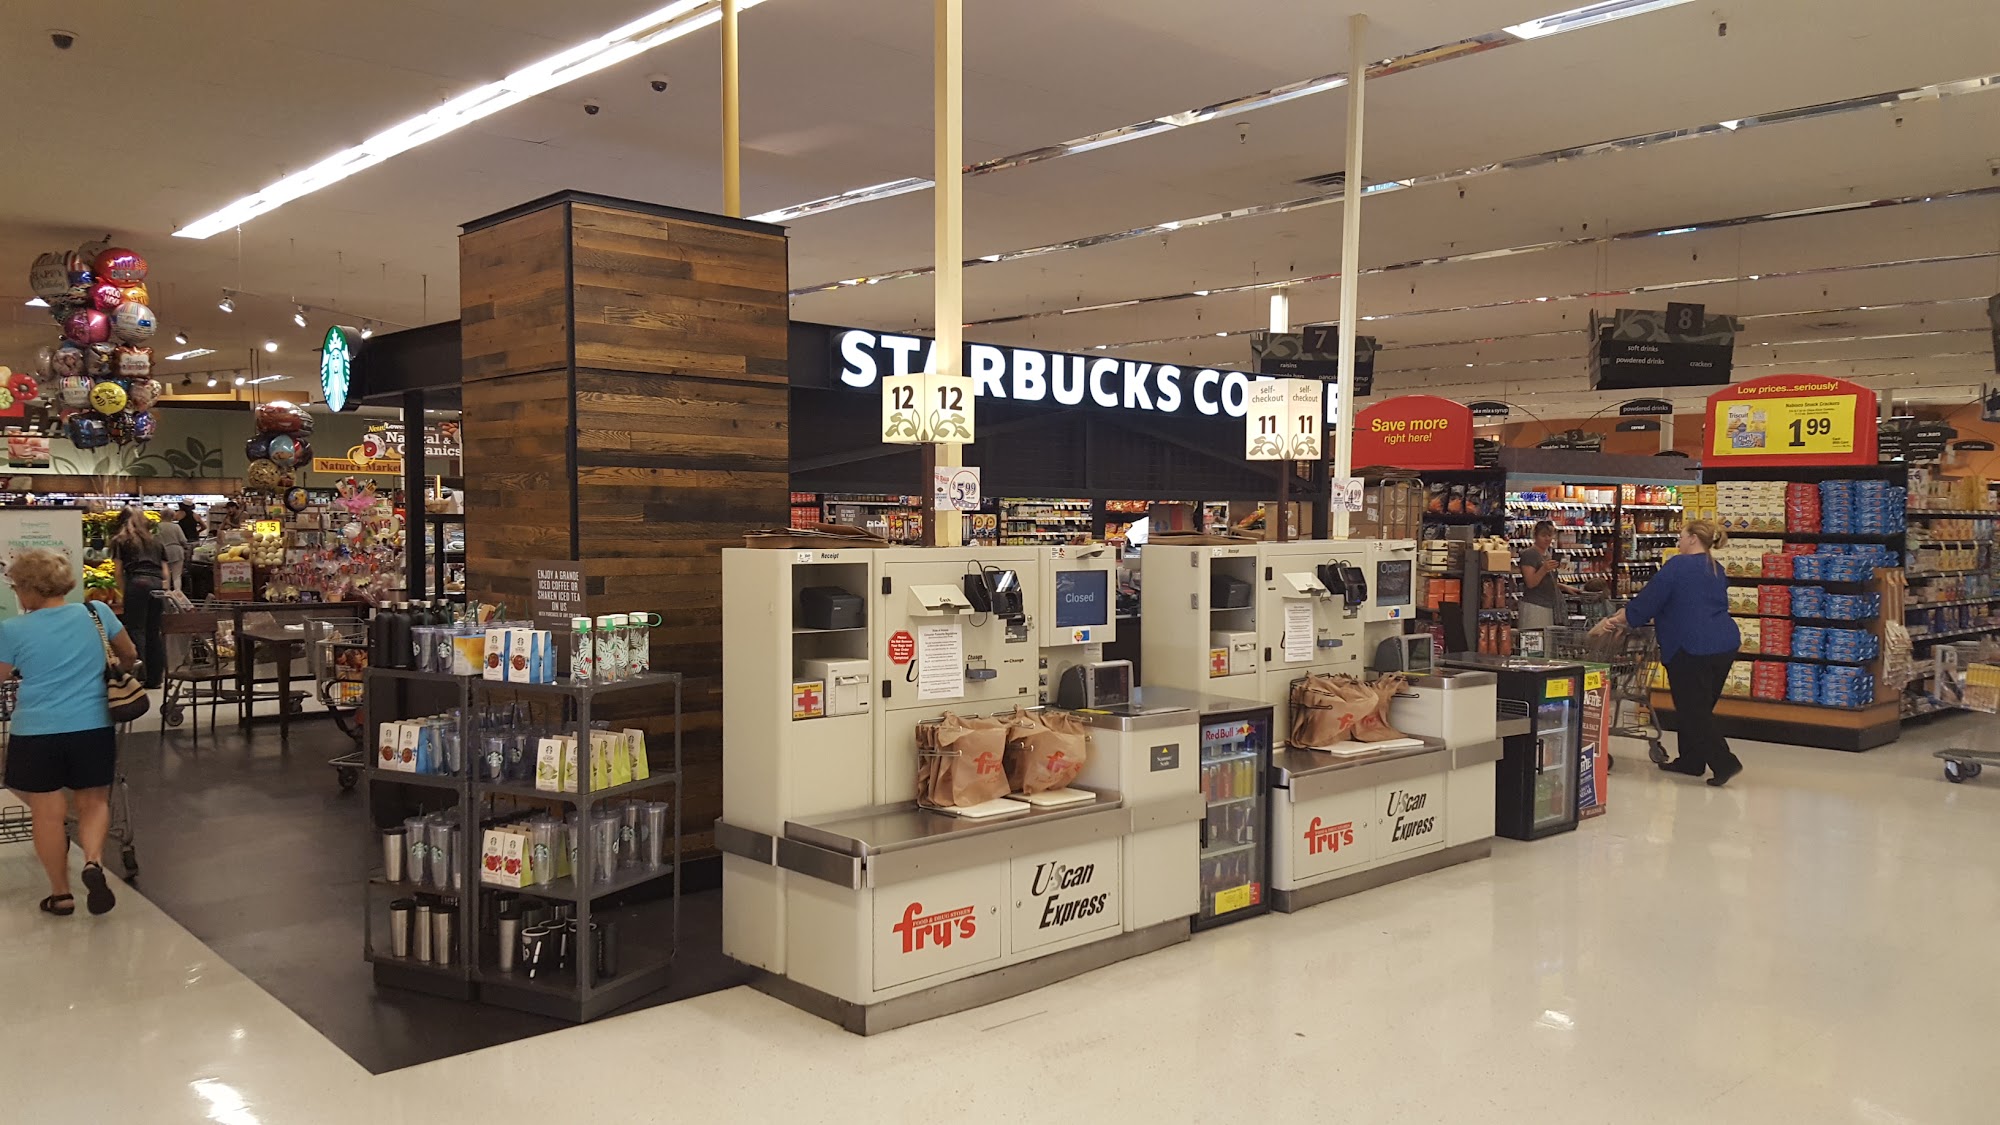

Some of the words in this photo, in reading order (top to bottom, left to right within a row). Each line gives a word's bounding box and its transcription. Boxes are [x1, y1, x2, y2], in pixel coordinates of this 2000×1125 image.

[1678, 308, 1693, 330] 8
[1314, 330, 1327, 349] 7
[1616, 357, 1647, 365] powdered
[1647, 357, 1665, 365] drinks
[1689, 360, 1713, 368] crackers
[1260, 385, 1276, 395] self-
[1299, 385, 1312, 393] self-
[1738, 385, 1756, 394] Low
[892, 385, 914, 410] 12
[937, 386, 963, 411] 12
[1251, 394, 1284, 404] checkout
[1292, 394, 1318, 403] checkout
[1495, 407, 1509, 415] syrup
[1258, 415, 1277, 434] 11
[1298, 415, 1313, 434] 11
[1371, 417, 1406, 432] Save
[1410, 418, 1449, 430] more
[442, 436, 451, 444] &
[1384, 434, 1406, 446] right
[1408, 432, 1432, 442] here!
[537, 569, 553, 579] ENJOY
[554, 570, 559, 579] A
[559, 571, 580, 580] GRANDE
[539, 580, 550, 590] ICED
[551, 581, 570, 590] COFFEE
[571, 582, 579, 591] OR
[537, 590, 557, 600] SHAKEN
[558, 591, 570, 601] ICED
[571, 592, 581, 602] TEA
[1065, 592, 1095, 603] Closed
[551, 601, 559, 611] ON
[559, 602, 568, 611] US
[1391, 815, 1435, 843] Express
[1304, 816, 1354, 855] fry's
[934, 913, 950, 922] DRUG
[950, 908, 971, 917] STORES
[1038, 892, 1107, 929] Express
[892, 902, 976, 954] fry's
